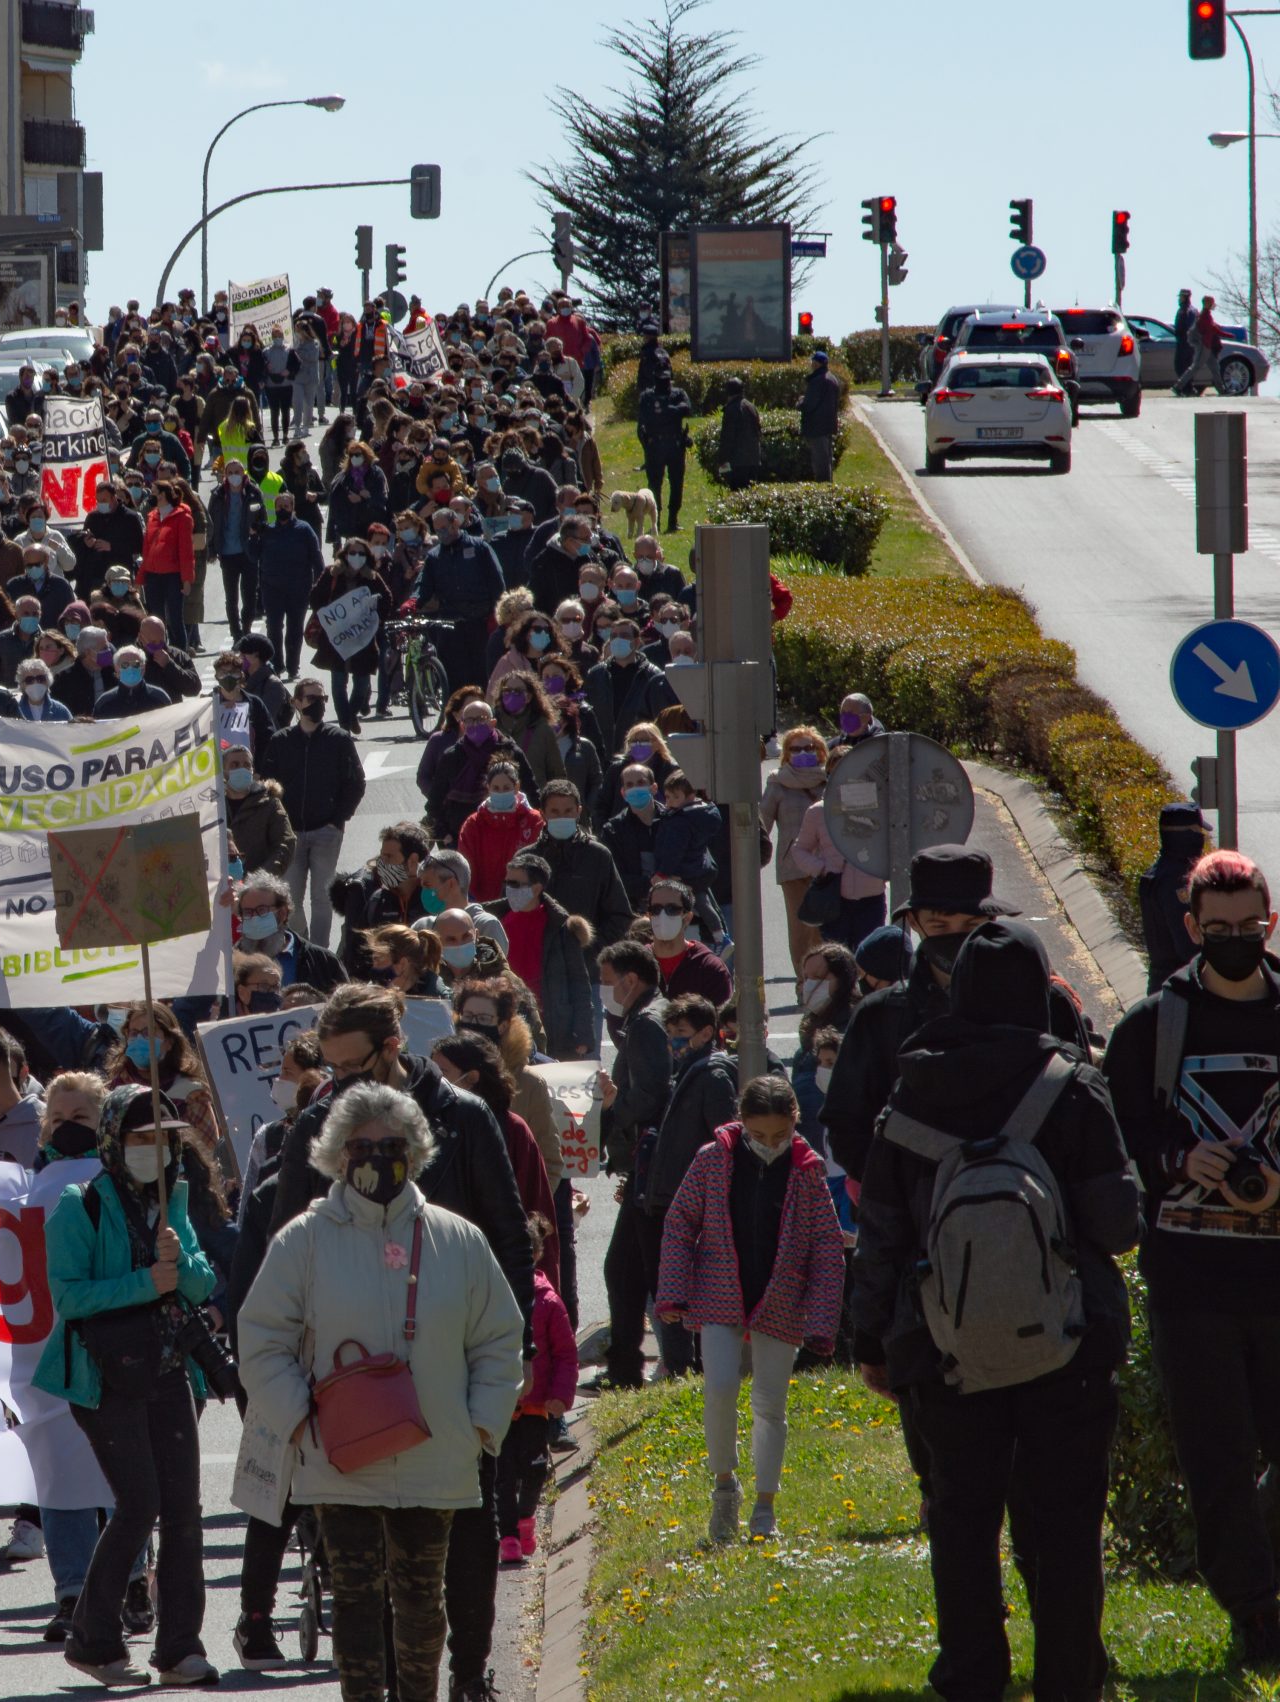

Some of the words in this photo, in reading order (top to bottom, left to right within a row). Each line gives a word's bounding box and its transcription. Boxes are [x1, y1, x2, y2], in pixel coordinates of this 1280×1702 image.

[232, 290, 248, 302] USO
[248, 284, 273, 298] PARA
[273, 279, 284, 289] EL
[42, 432, 107, 458] arking
[323, 603, 348, 627] NO
[81, 737, 169, 788] PARA
[173, 720, 210, 752] EL
[5, 894, 48, 920] NO
[562, 1120, 587, 1144] de
